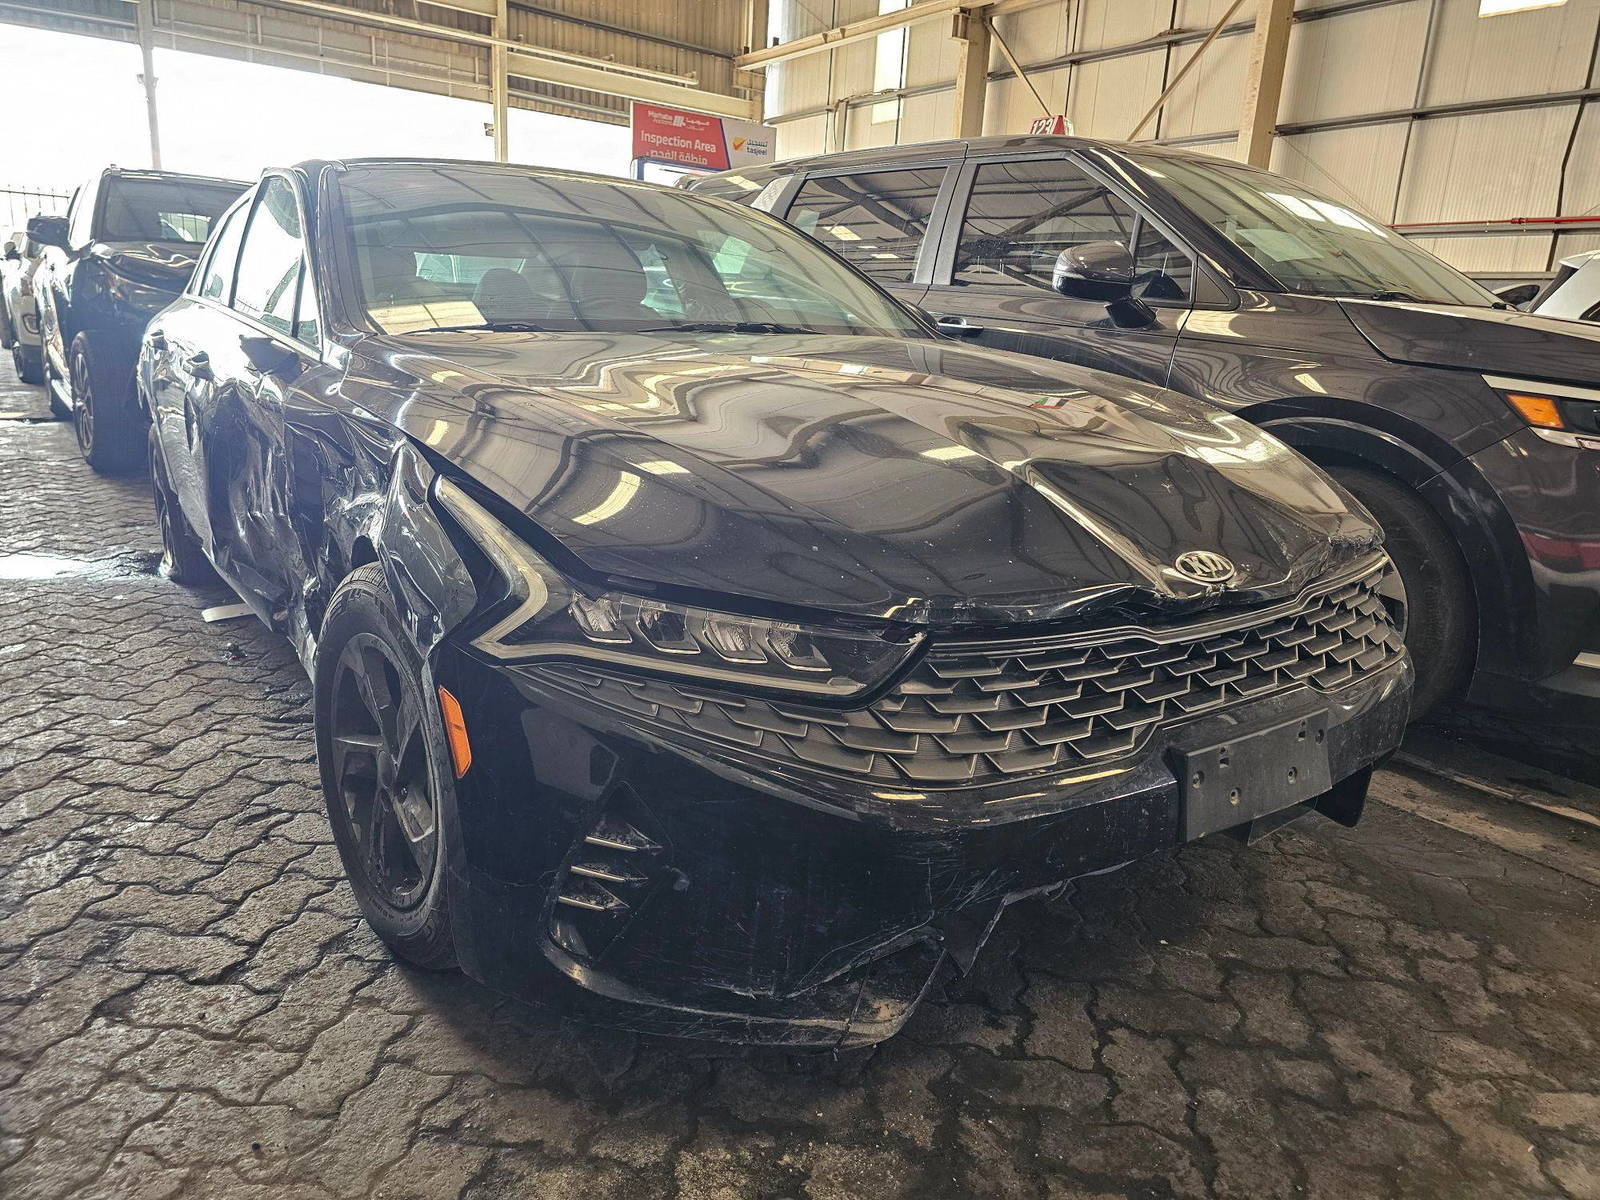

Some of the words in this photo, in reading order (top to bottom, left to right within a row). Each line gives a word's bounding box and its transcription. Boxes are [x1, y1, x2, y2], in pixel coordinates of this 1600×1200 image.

[640, 129, 692, 149] Inspection
[694, 139, 717, 153] Area
[1180, 553, 1232, 578] KIA
